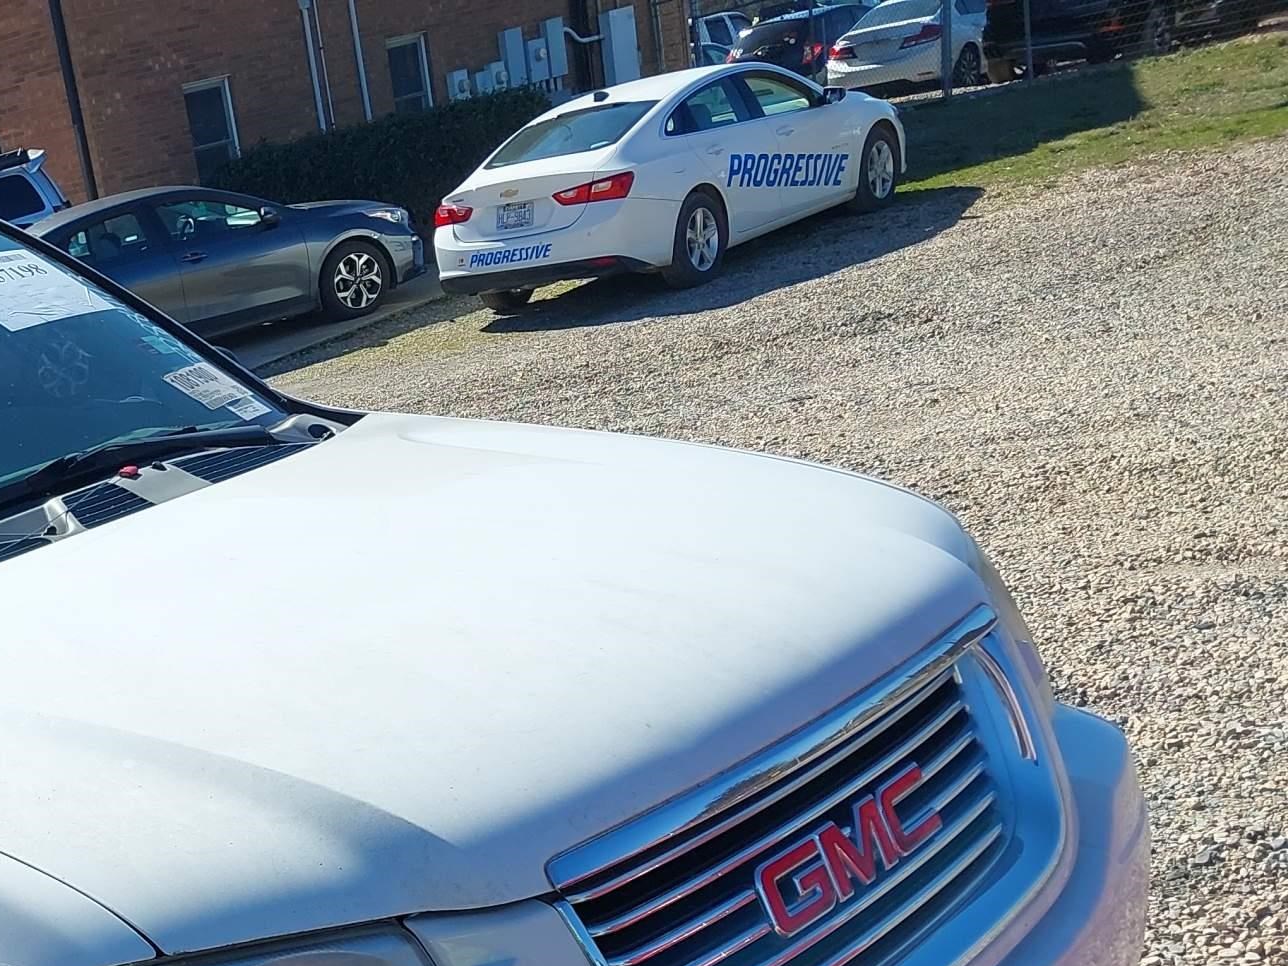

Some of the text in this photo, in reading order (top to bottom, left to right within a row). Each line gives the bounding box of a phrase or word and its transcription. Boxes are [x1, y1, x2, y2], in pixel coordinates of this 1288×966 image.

[727, 153, 849, 187] PROGRESSIVE
[469, 243, 552, 267] PROGRESSIVE
[754, 761, 943, 938] GMC
